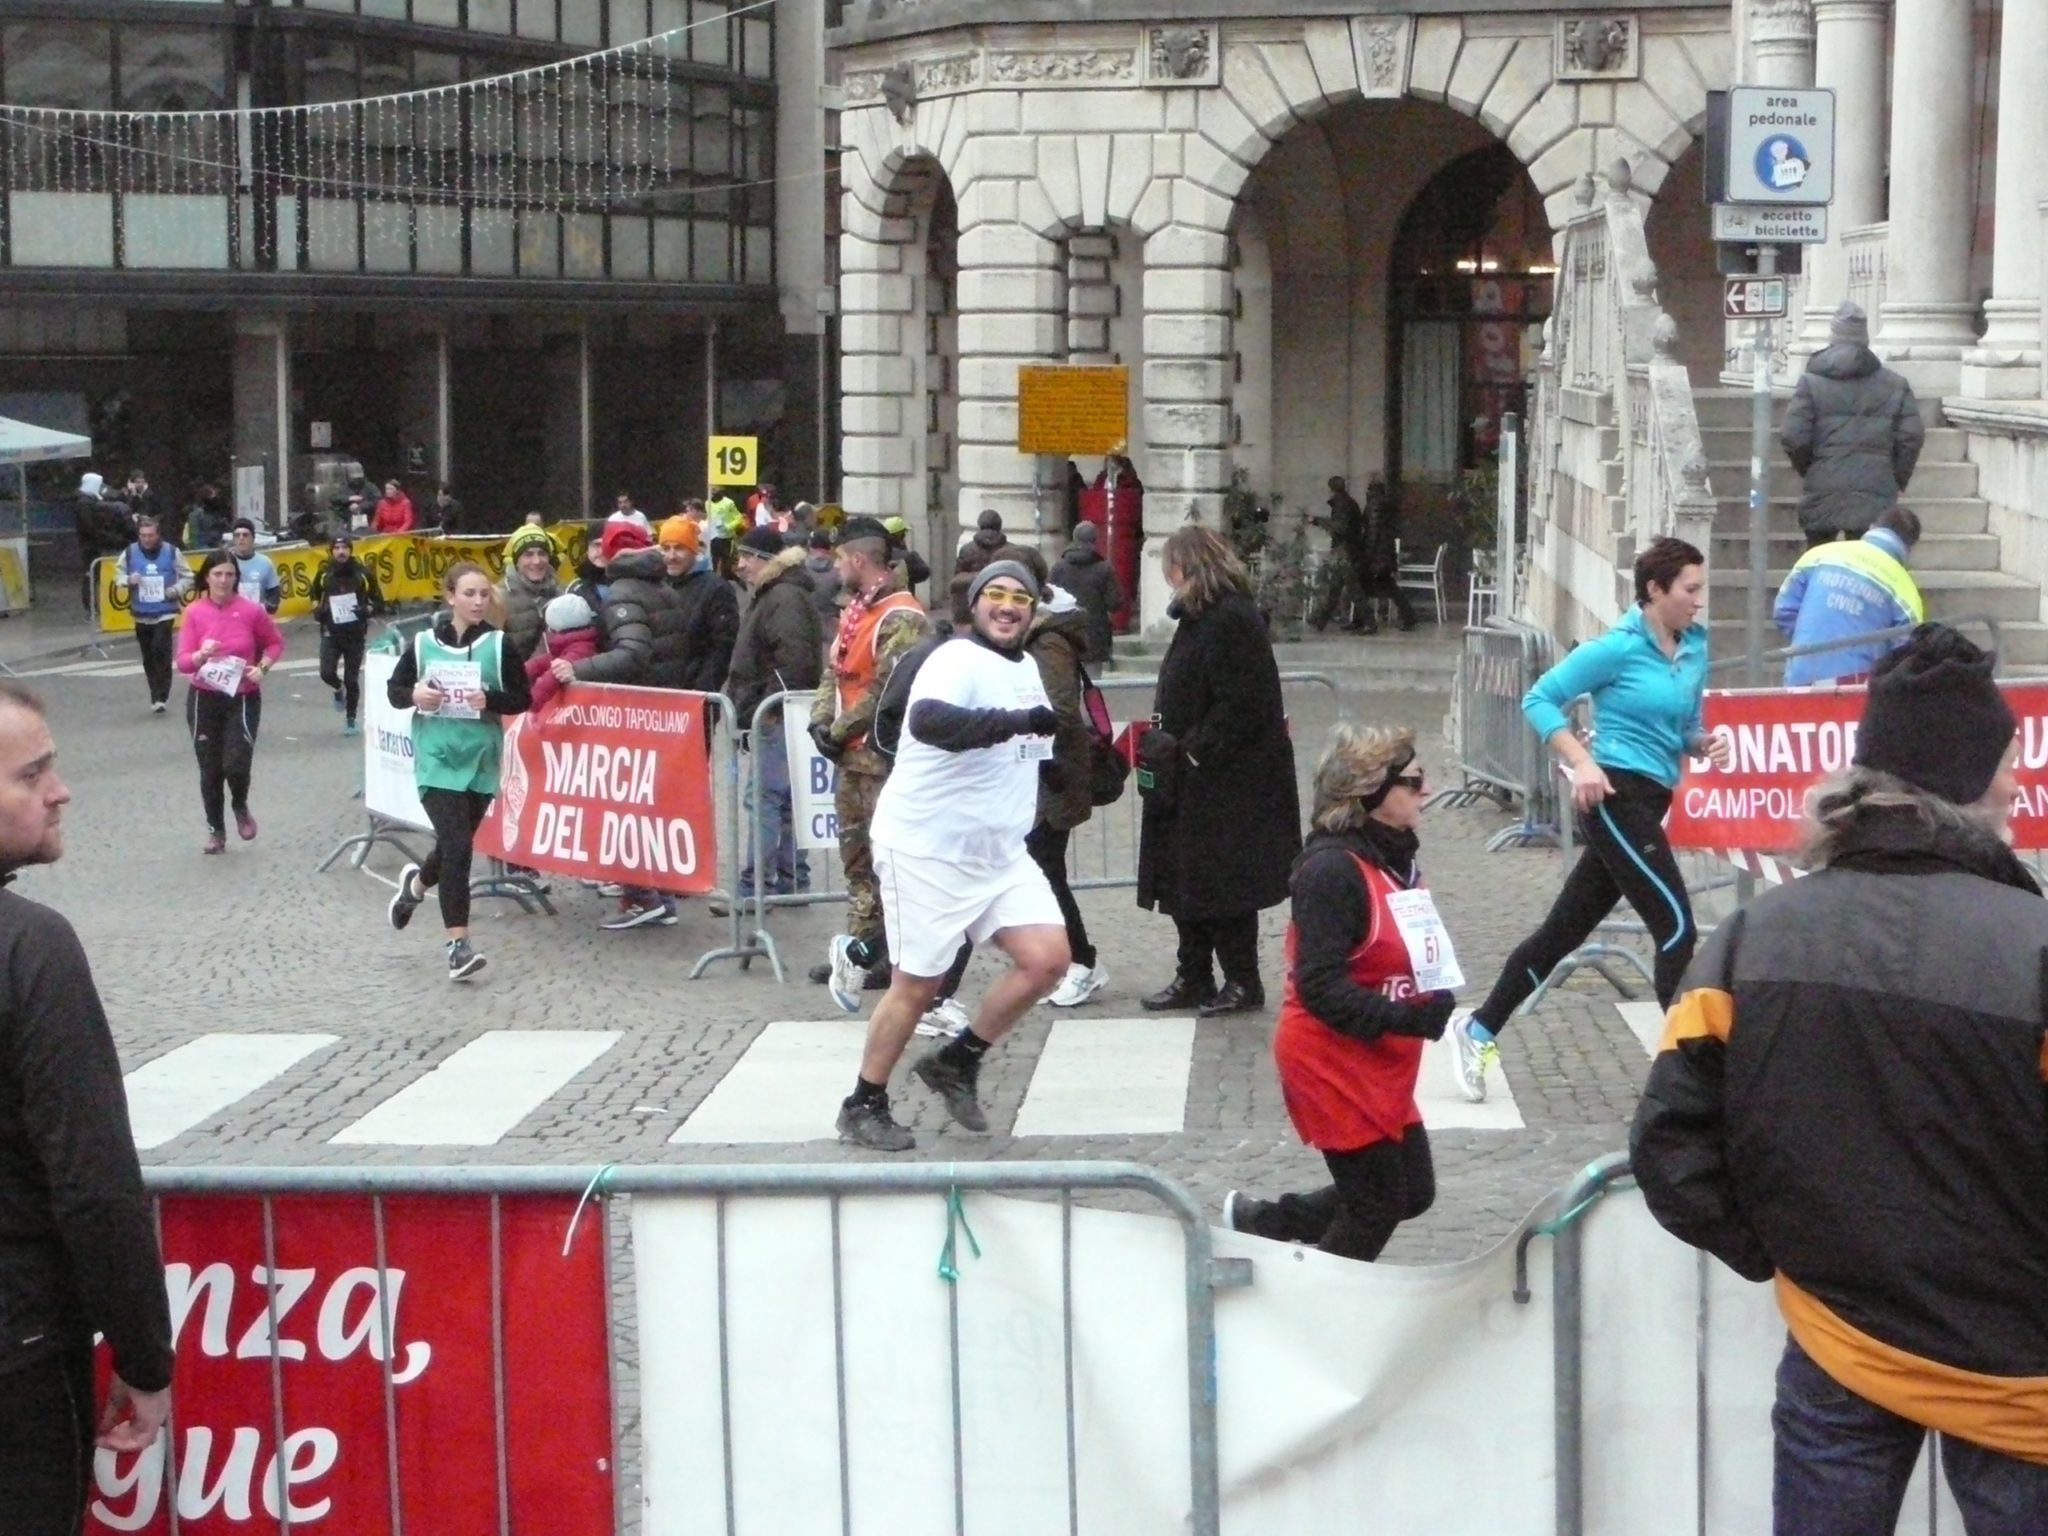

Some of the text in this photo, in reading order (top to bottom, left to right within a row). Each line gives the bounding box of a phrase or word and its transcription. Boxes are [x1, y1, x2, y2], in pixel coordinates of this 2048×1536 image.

[1766, 97, 1798, 108] area
[1749, 113, 1817, 127] pedonale
[1755, 225, 1819, 237] biciclette
[716, 446, 747, 476] 19
[207, 668, 232, 686] 215
[624, 707, 690, 734] TAPOGLIANO
[542, 740, 657, 805] MARCIA
[532, 802, 696, 875] DEL DONO
